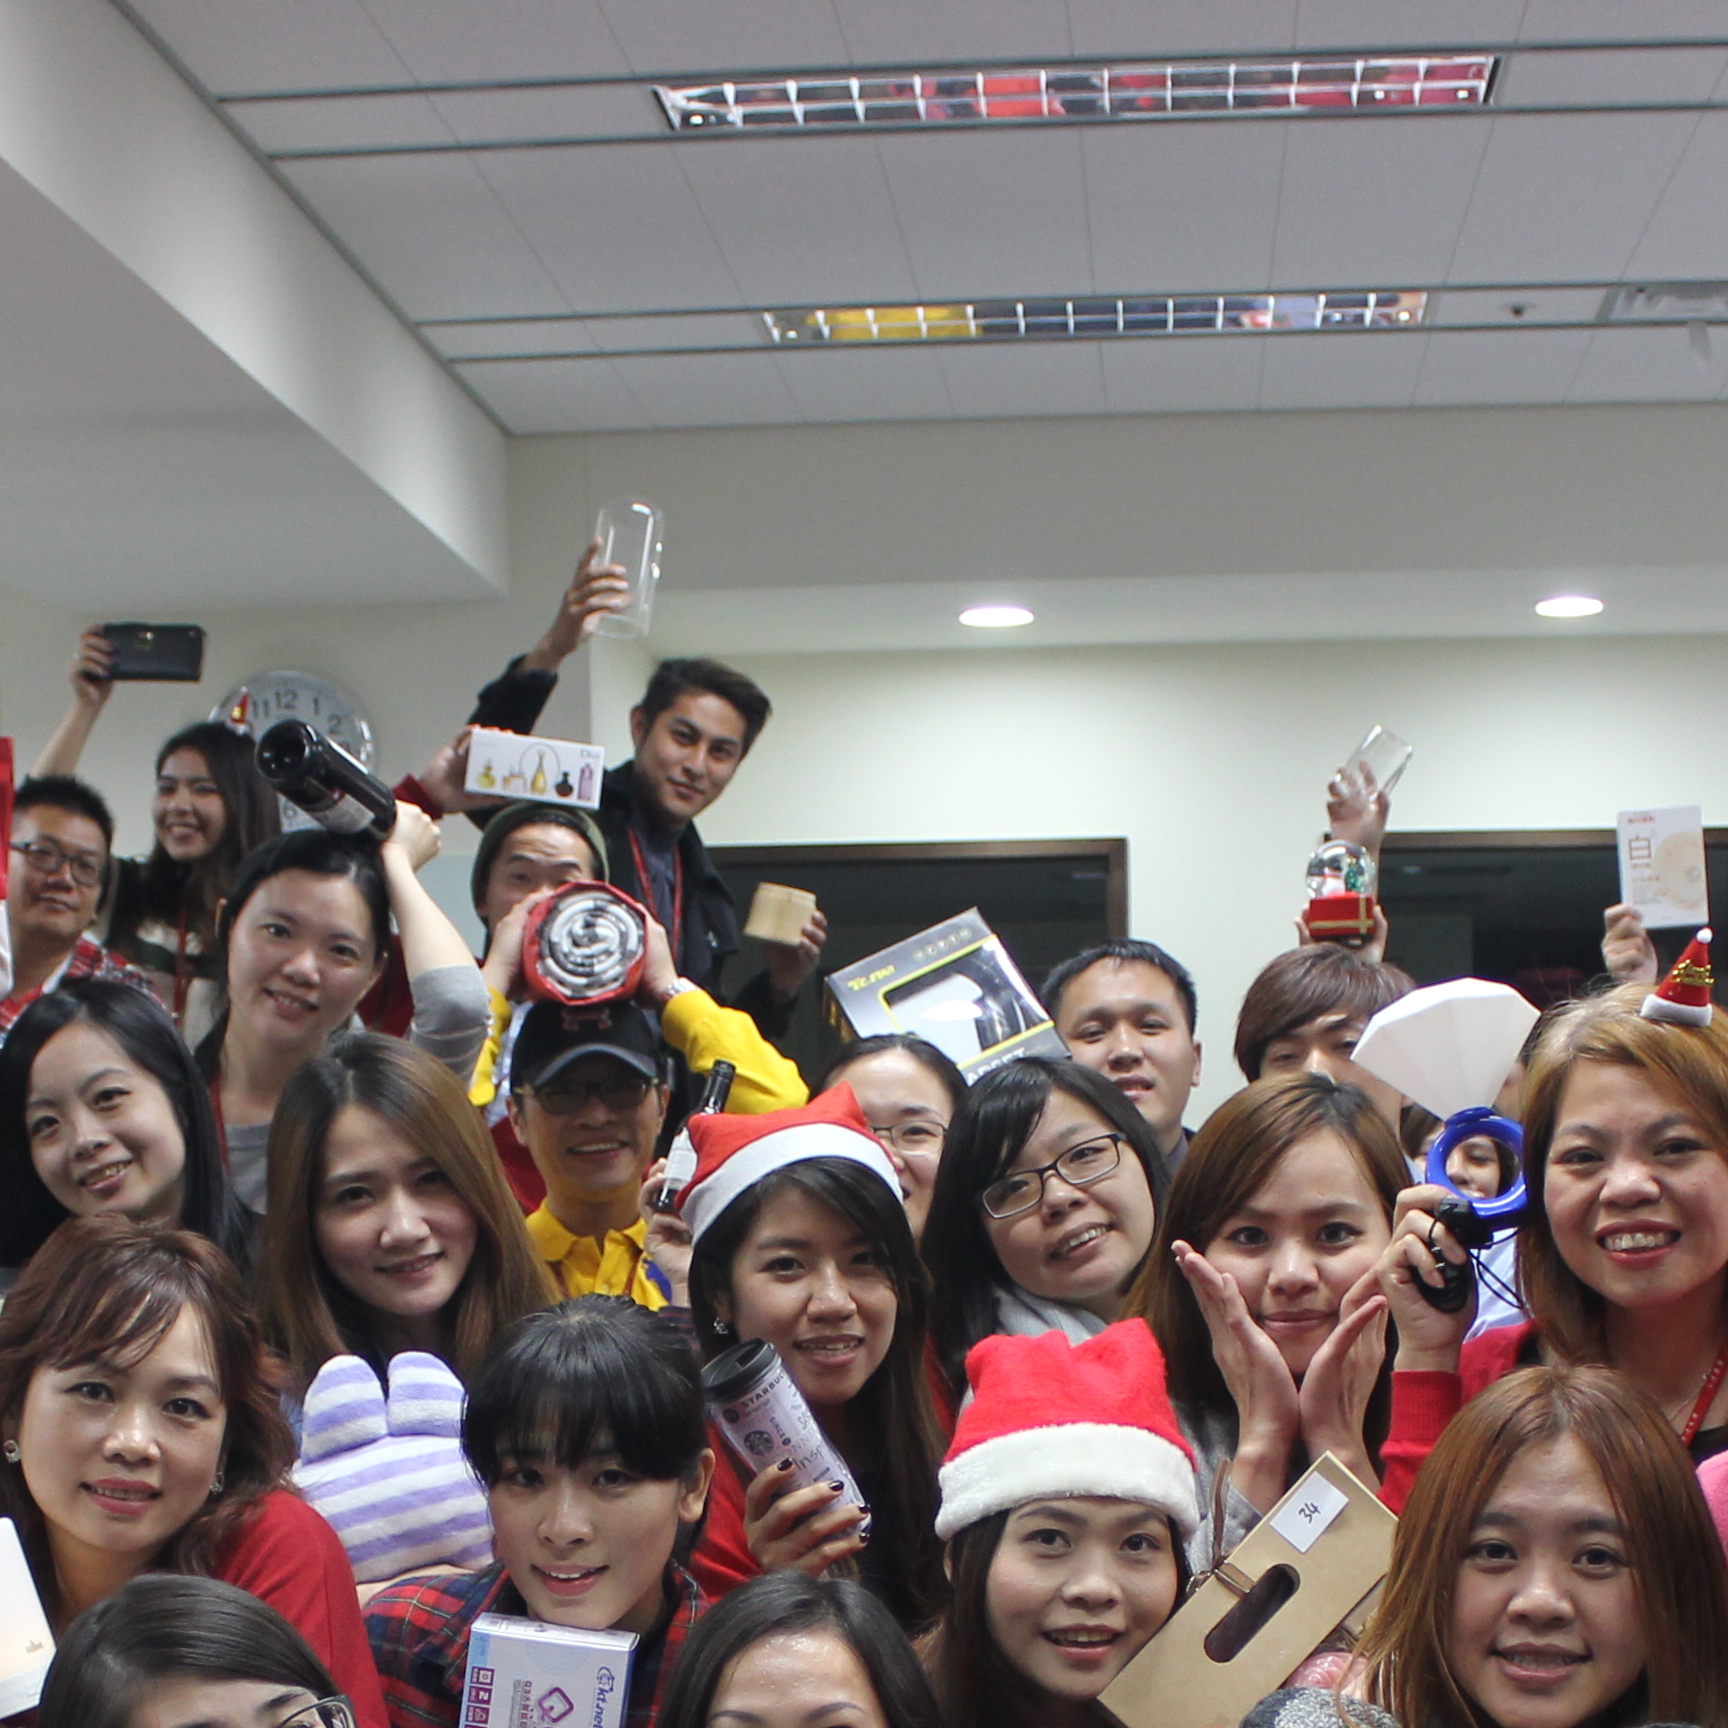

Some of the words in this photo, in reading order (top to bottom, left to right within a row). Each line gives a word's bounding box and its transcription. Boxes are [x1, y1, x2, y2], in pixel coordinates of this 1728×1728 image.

[252, 700, 270, 718] 11
[275, 689, 298, 710] 12
[313, 697, 320, 716] 1
[327, 714, 342, 735] 2
[1298, 1502, 1322, 1525] 34
